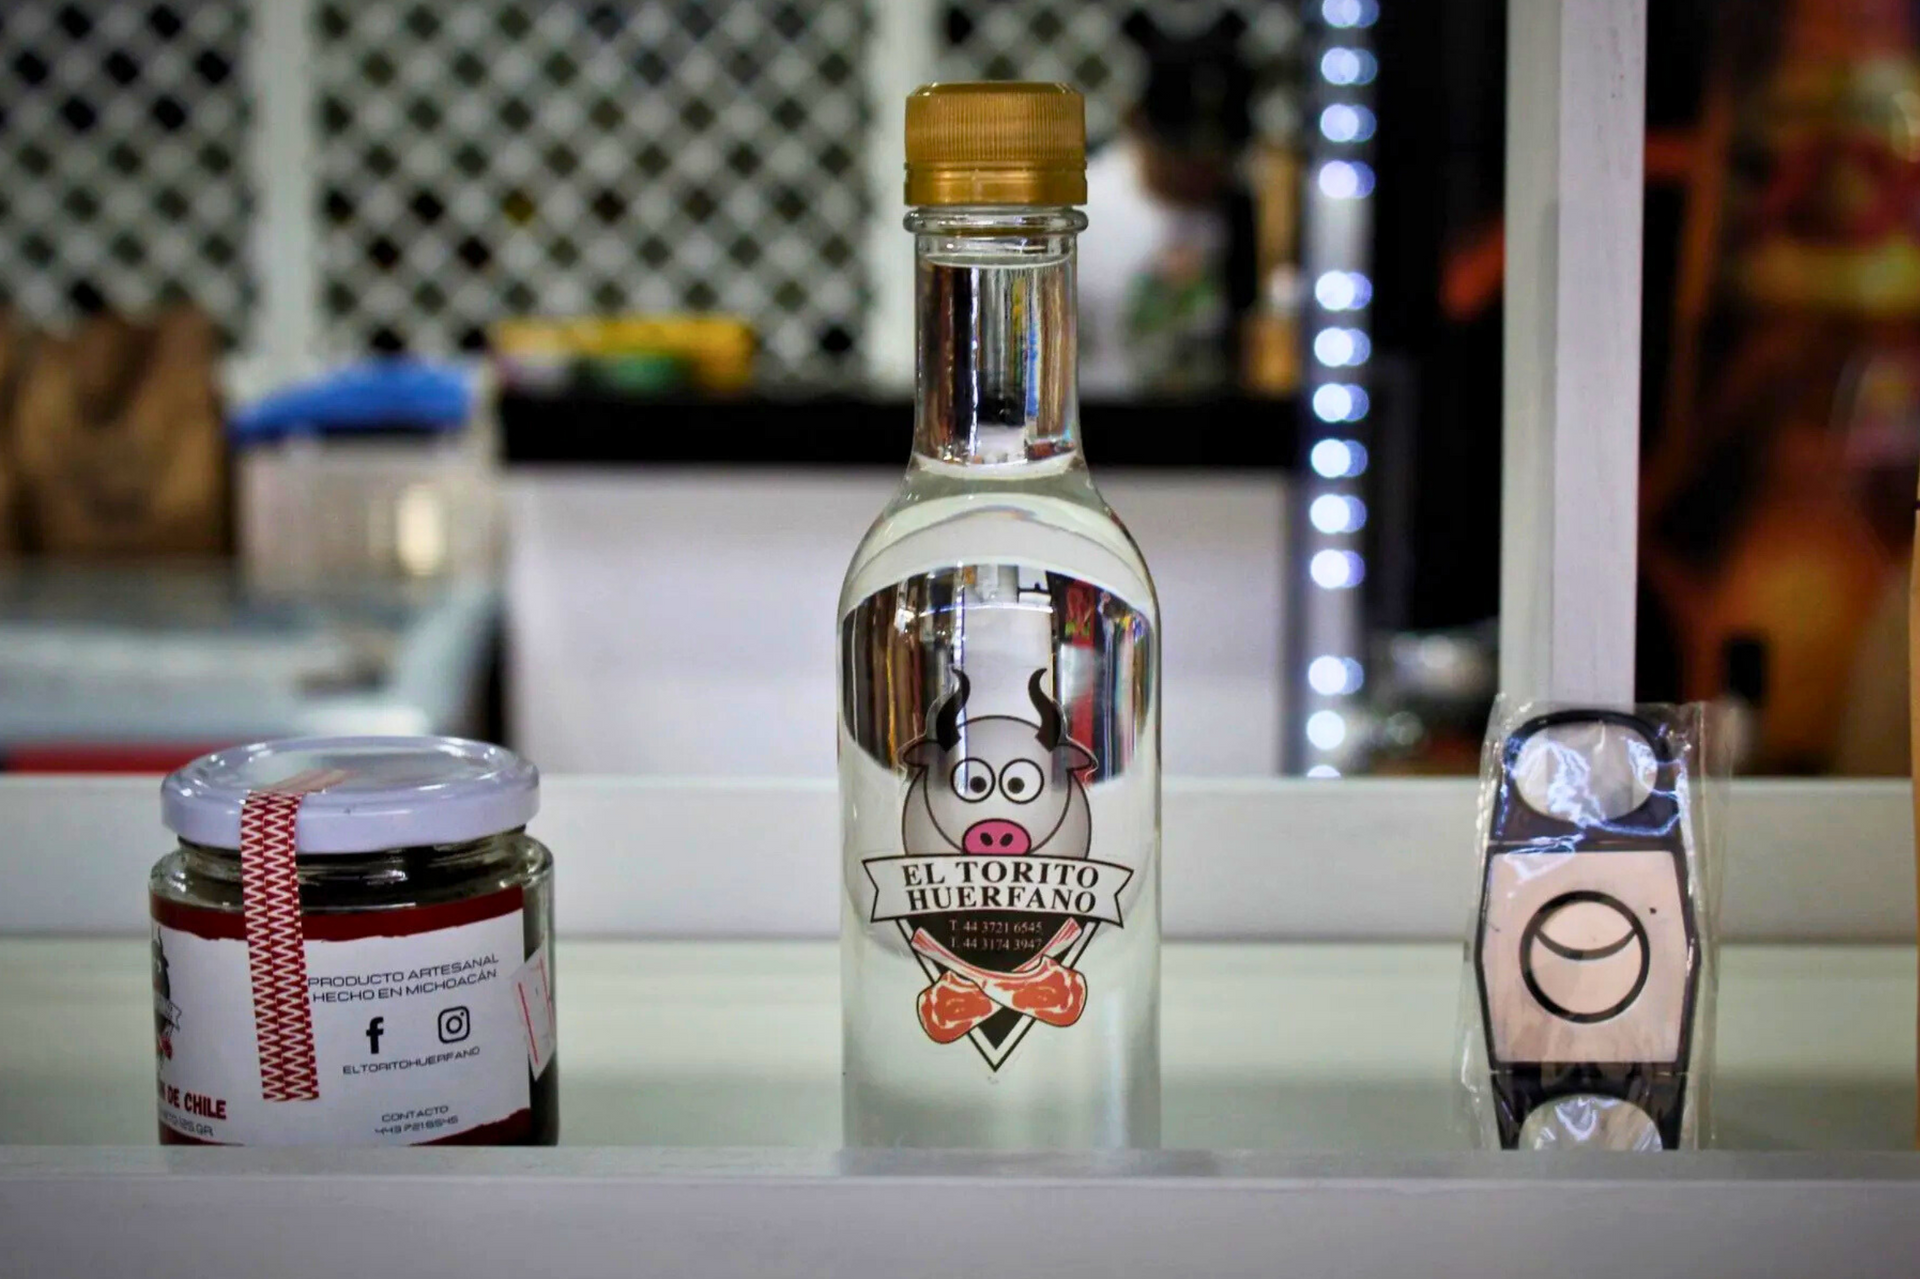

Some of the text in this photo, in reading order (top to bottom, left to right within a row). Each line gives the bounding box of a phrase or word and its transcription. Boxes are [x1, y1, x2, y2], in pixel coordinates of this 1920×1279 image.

[902, 860, 1099, 889] EL TORITO
[906, 886, 1097, 914] HUERFANO
[963, 920, 978, 932] 44
[981, 921, 1009, 934] 3721
[1013, 921, 1043, 934] 6545
[963, 937, 978, 949] 44
[981, 938, 1010, 950] 3174
[308, 953, 499, 988] PRODUCTO ARTESANAL
[313, 968, 497, 1003] HECHO EN MICHOACÁN
[342, 1046, 480, 1075] ELTORITOHUERFANO
[167, 1084, 180, 1109] DE
[184, 1091, 227, 1120] CHILE
[381, 1105, 449, 1123] CONTACTO
